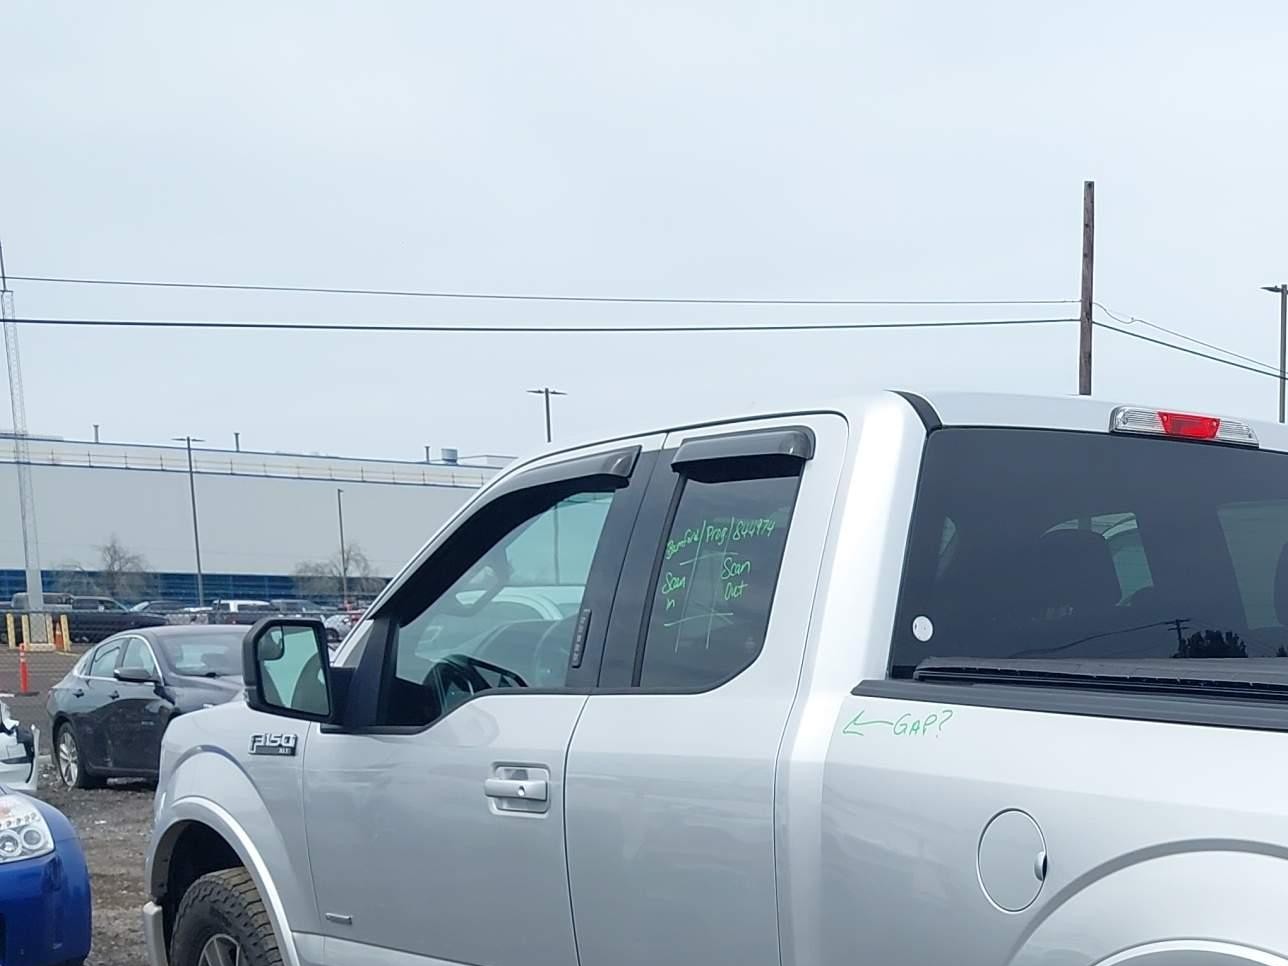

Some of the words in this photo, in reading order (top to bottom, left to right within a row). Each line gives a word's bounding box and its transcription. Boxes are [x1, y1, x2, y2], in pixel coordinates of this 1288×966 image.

[721, 557, 751, 580] Scan
[661, 571, 686, 595] Scan
[893, 709, 954, 739] GAP?
